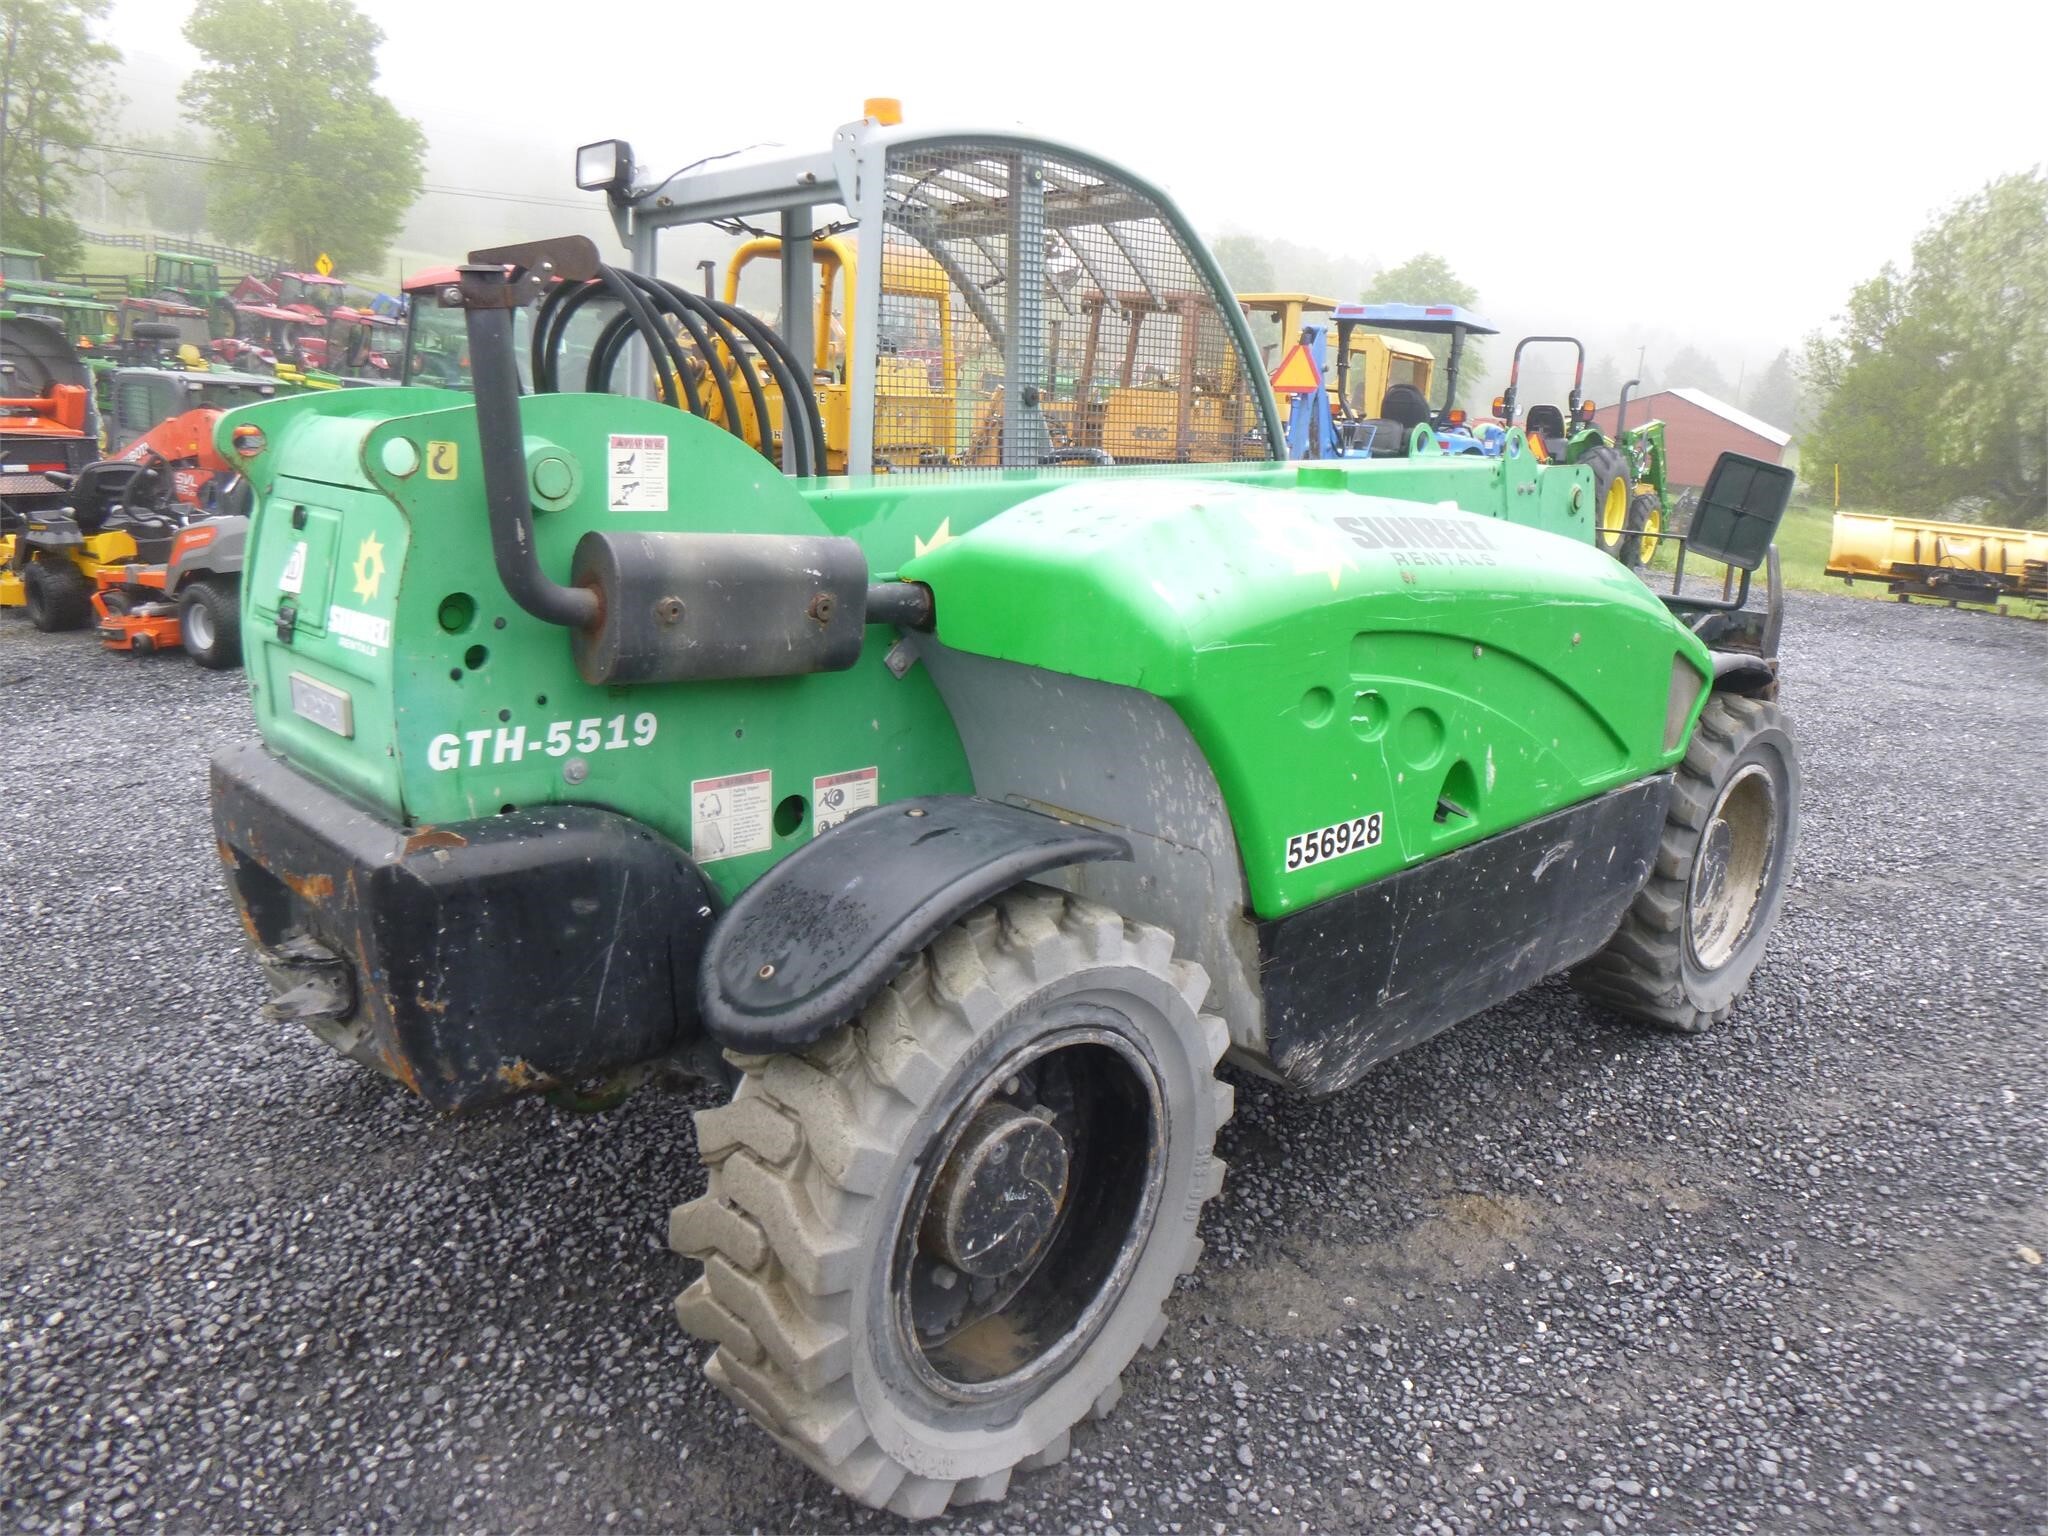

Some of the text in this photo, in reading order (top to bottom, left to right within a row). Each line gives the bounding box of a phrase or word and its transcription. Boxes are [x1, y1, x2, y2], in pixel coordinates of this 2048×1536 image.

[1333, 516, 1498, 550] SUNBELT
[1391, 552, 1496, 567] RENTALS
[427, 712, 658, 771] GTH-5519
[1287, 814, 1381, 869] 556928
